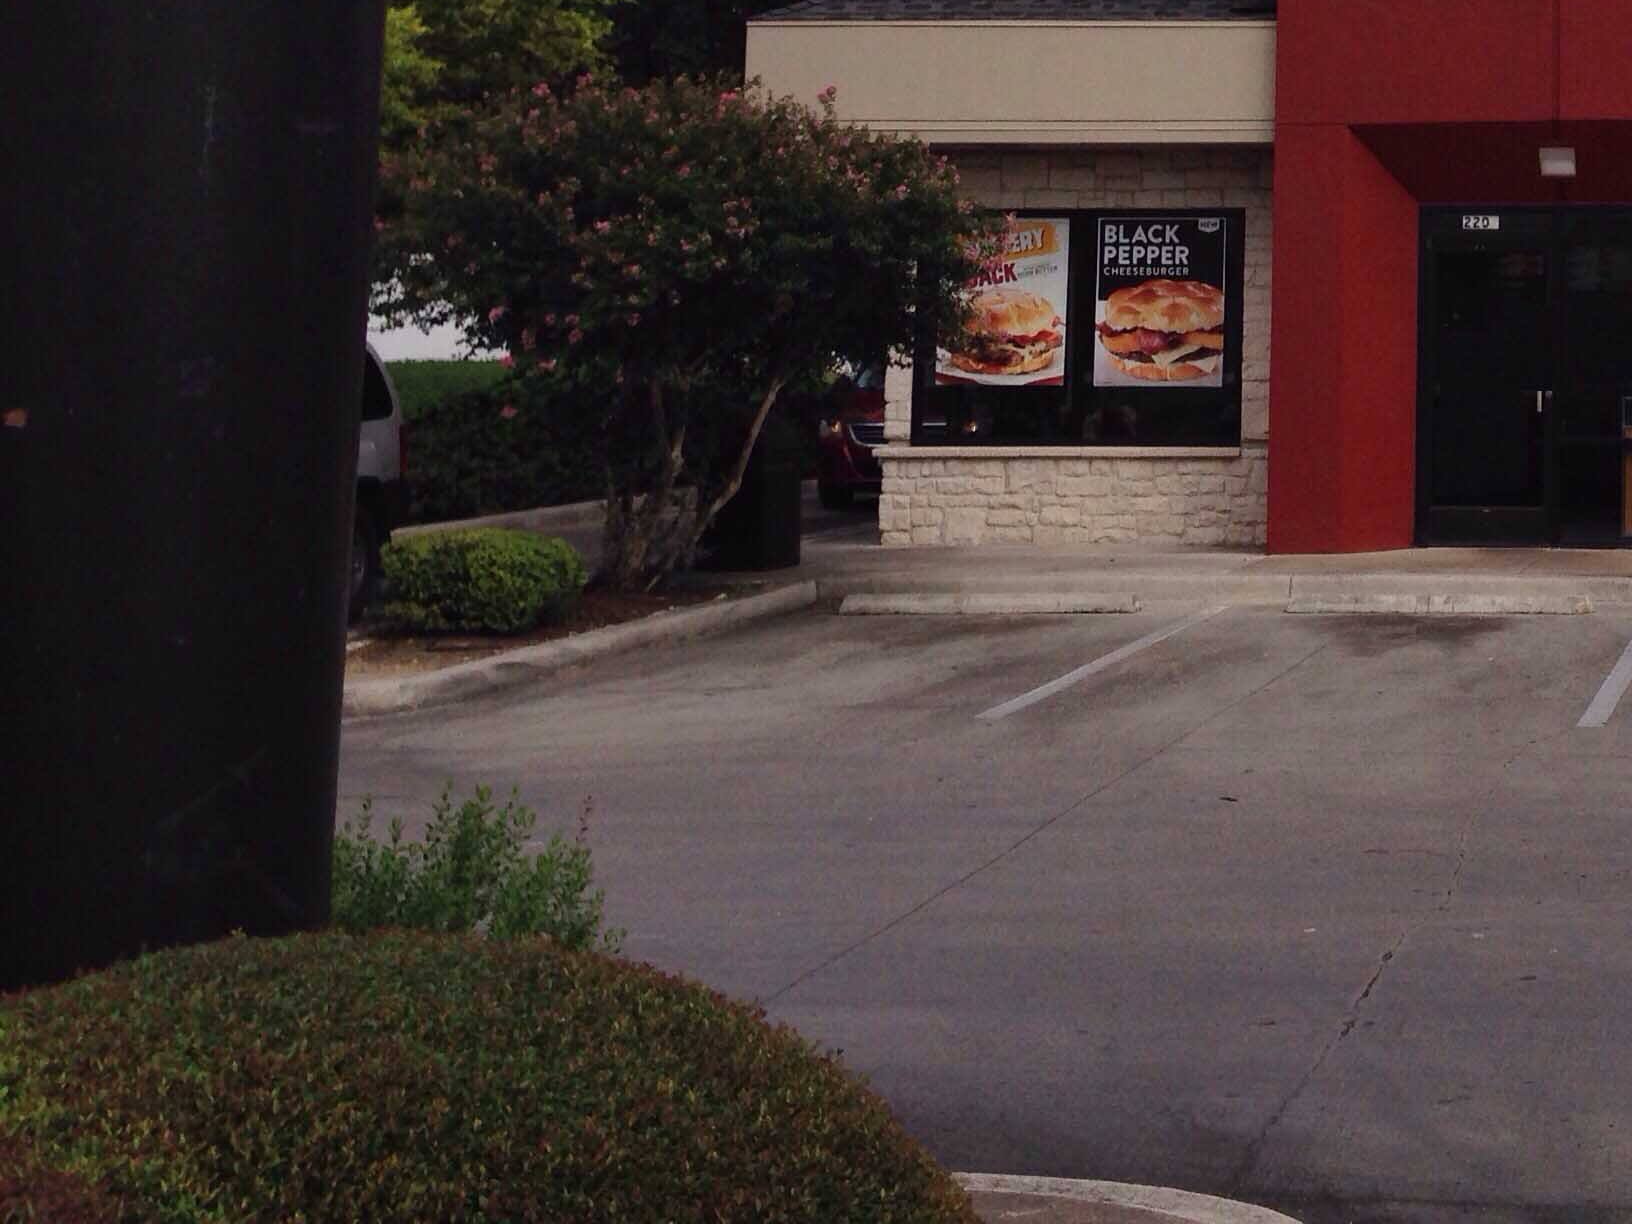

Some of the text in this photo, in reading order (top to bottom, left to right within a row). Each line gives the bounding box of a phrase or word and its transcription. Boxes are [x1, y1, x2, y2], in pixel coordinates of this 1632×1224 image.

[1104, 224, 1180, 244] BLACK
[1103, 246, 1190, 265] PEPPER
[1103, 266, 1190, 276] CHEESEBURGER
